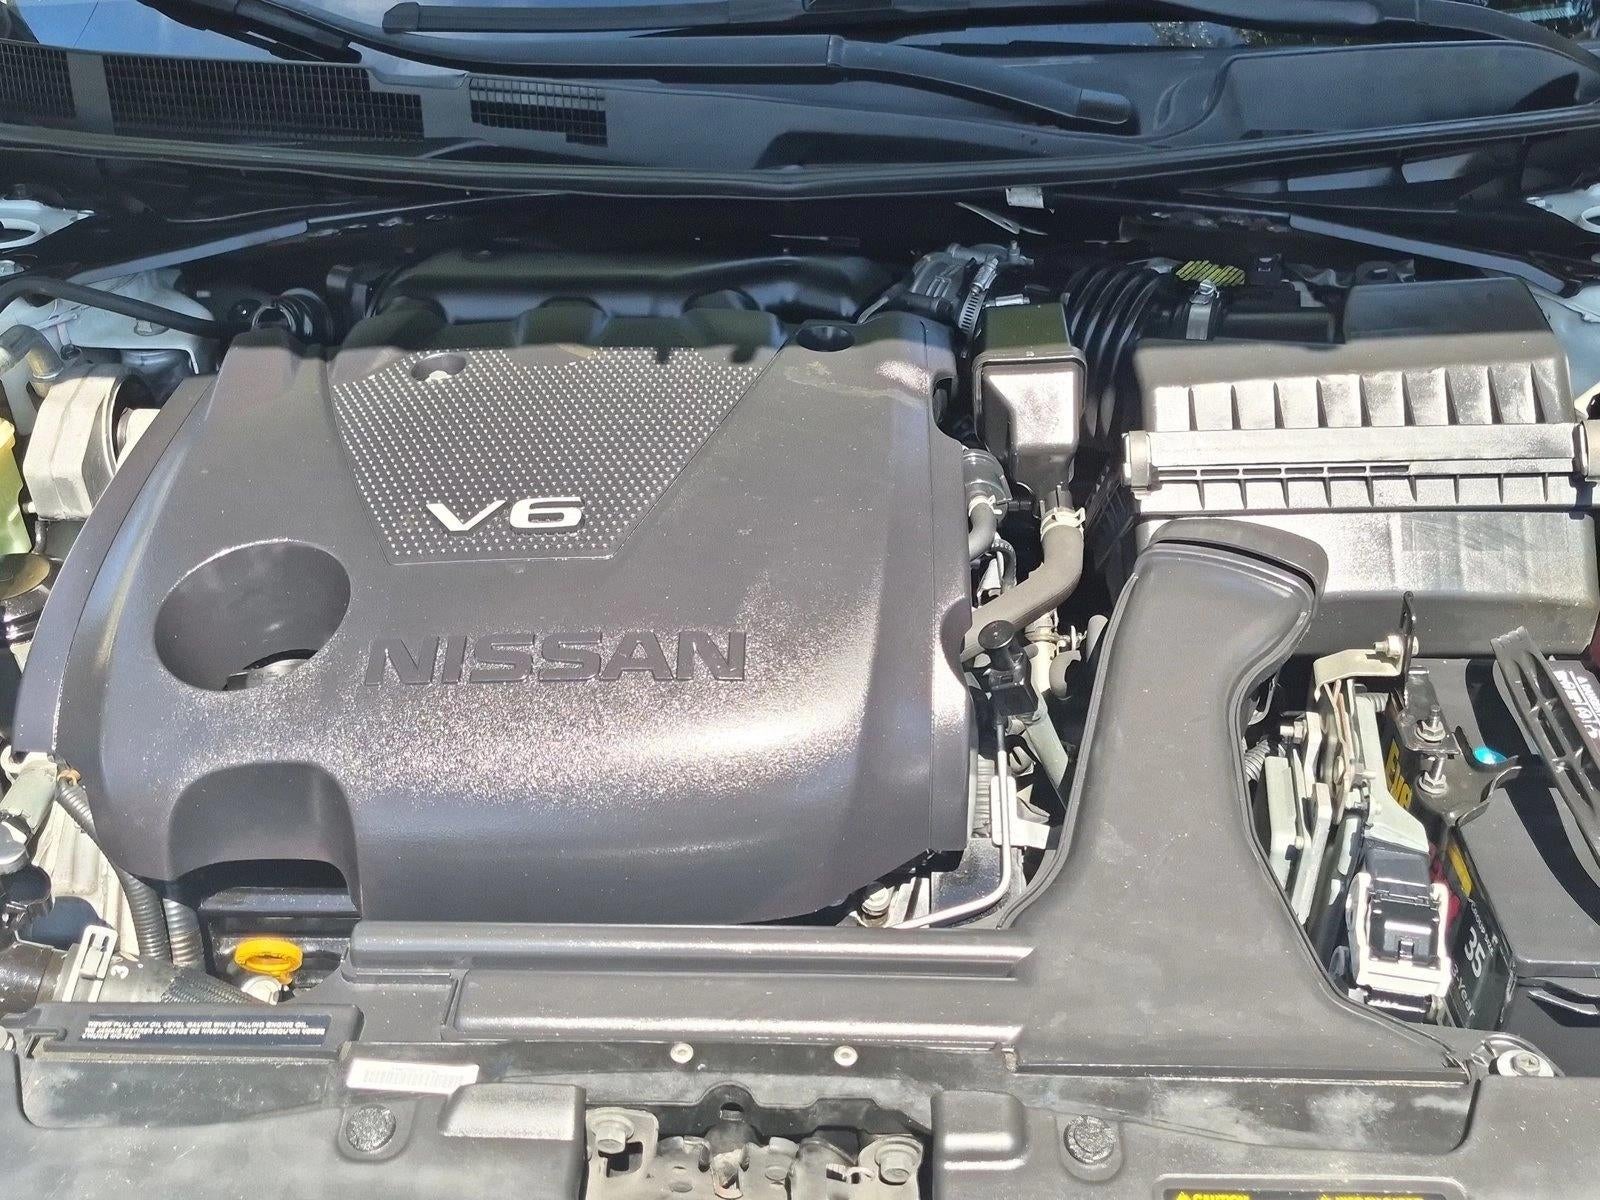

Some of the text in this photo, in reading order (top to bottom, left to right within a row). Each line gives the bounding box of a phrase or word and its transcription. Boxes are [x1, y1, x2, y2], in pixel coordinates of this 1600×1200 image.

[426, 496, 586, 535] V6
[365, 629, 747, 687] NISSAN
[1464, 926, 1486, 978] 35
[1451, 963, 1476, 1017] 3-Year
